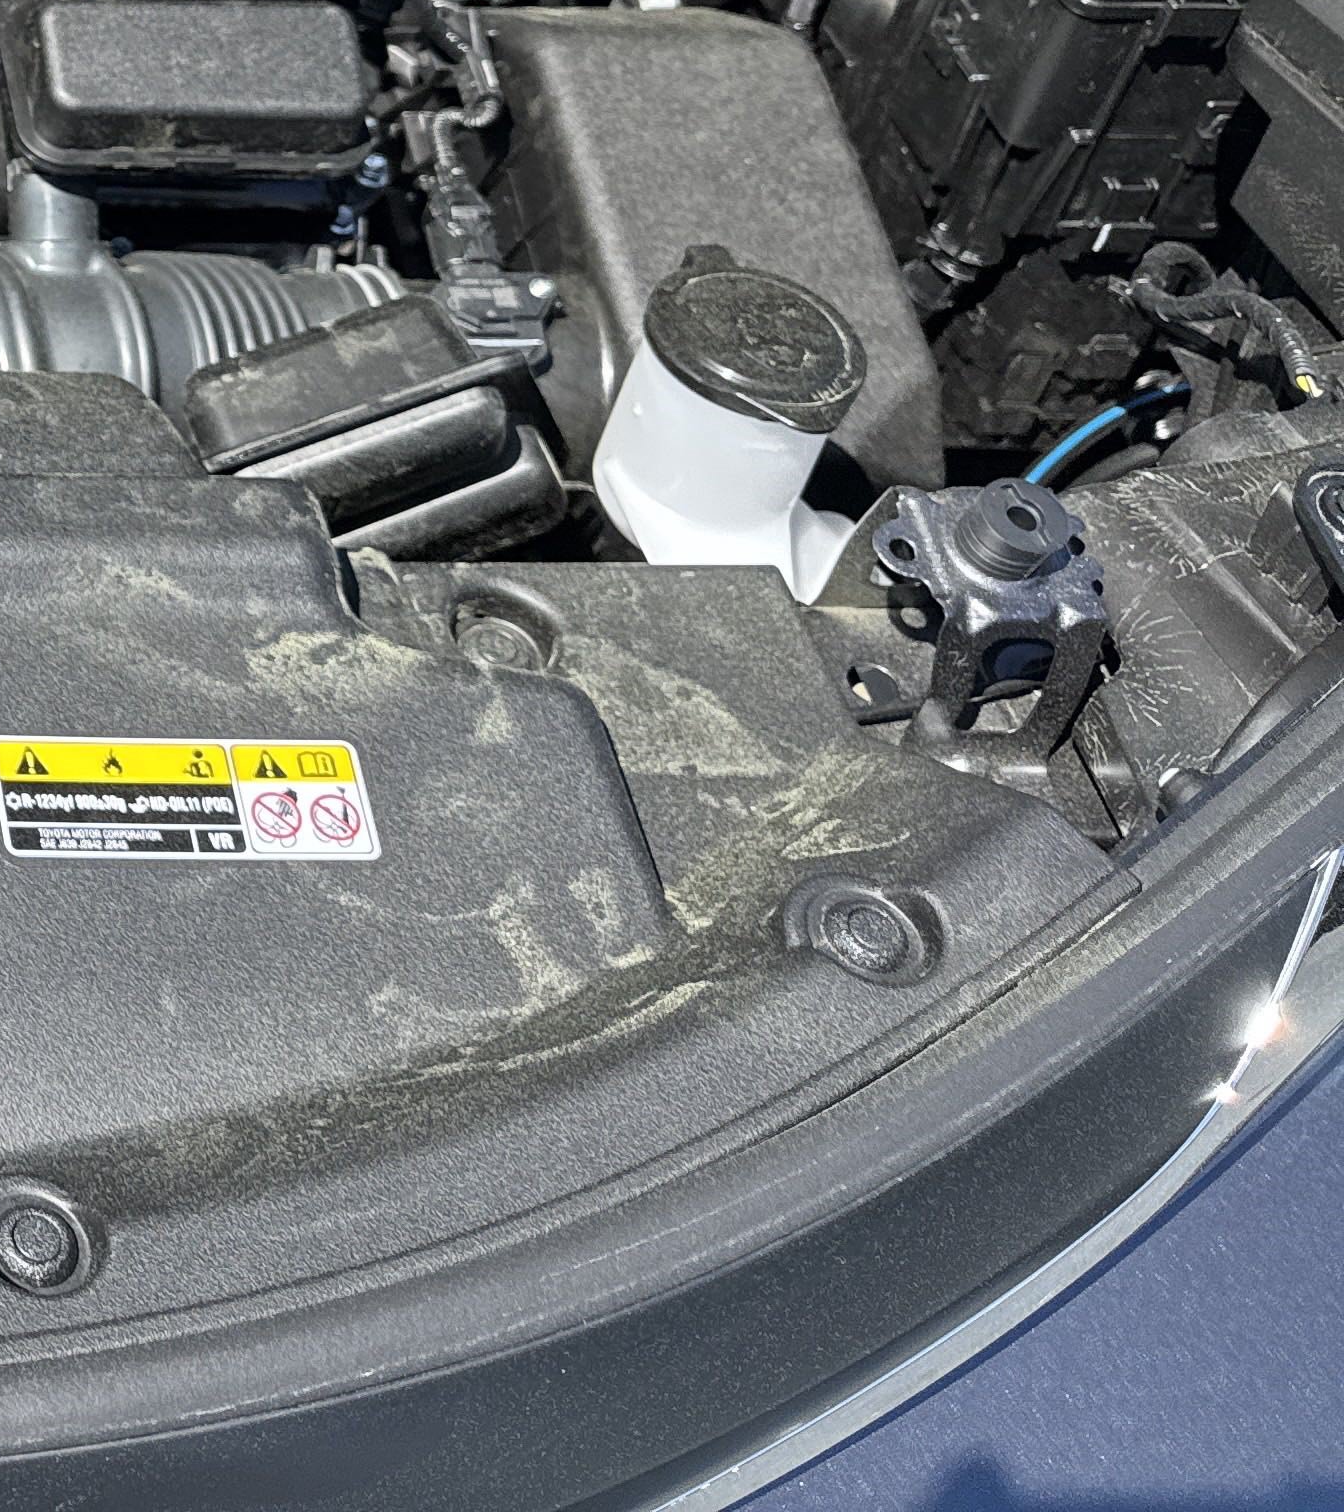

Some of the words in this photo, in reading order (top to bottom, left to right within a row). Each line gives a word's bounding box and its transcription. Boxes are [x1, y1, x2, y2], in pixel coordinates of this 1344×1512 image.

[37, 828, 72, 839] TOYOTA
[70, 829, 103, 839] MOTOR
[102, 829, 164, 841] CORPORATION
[39, 838, 57, 849] SAE
[207, 832, 236, 851] VR
